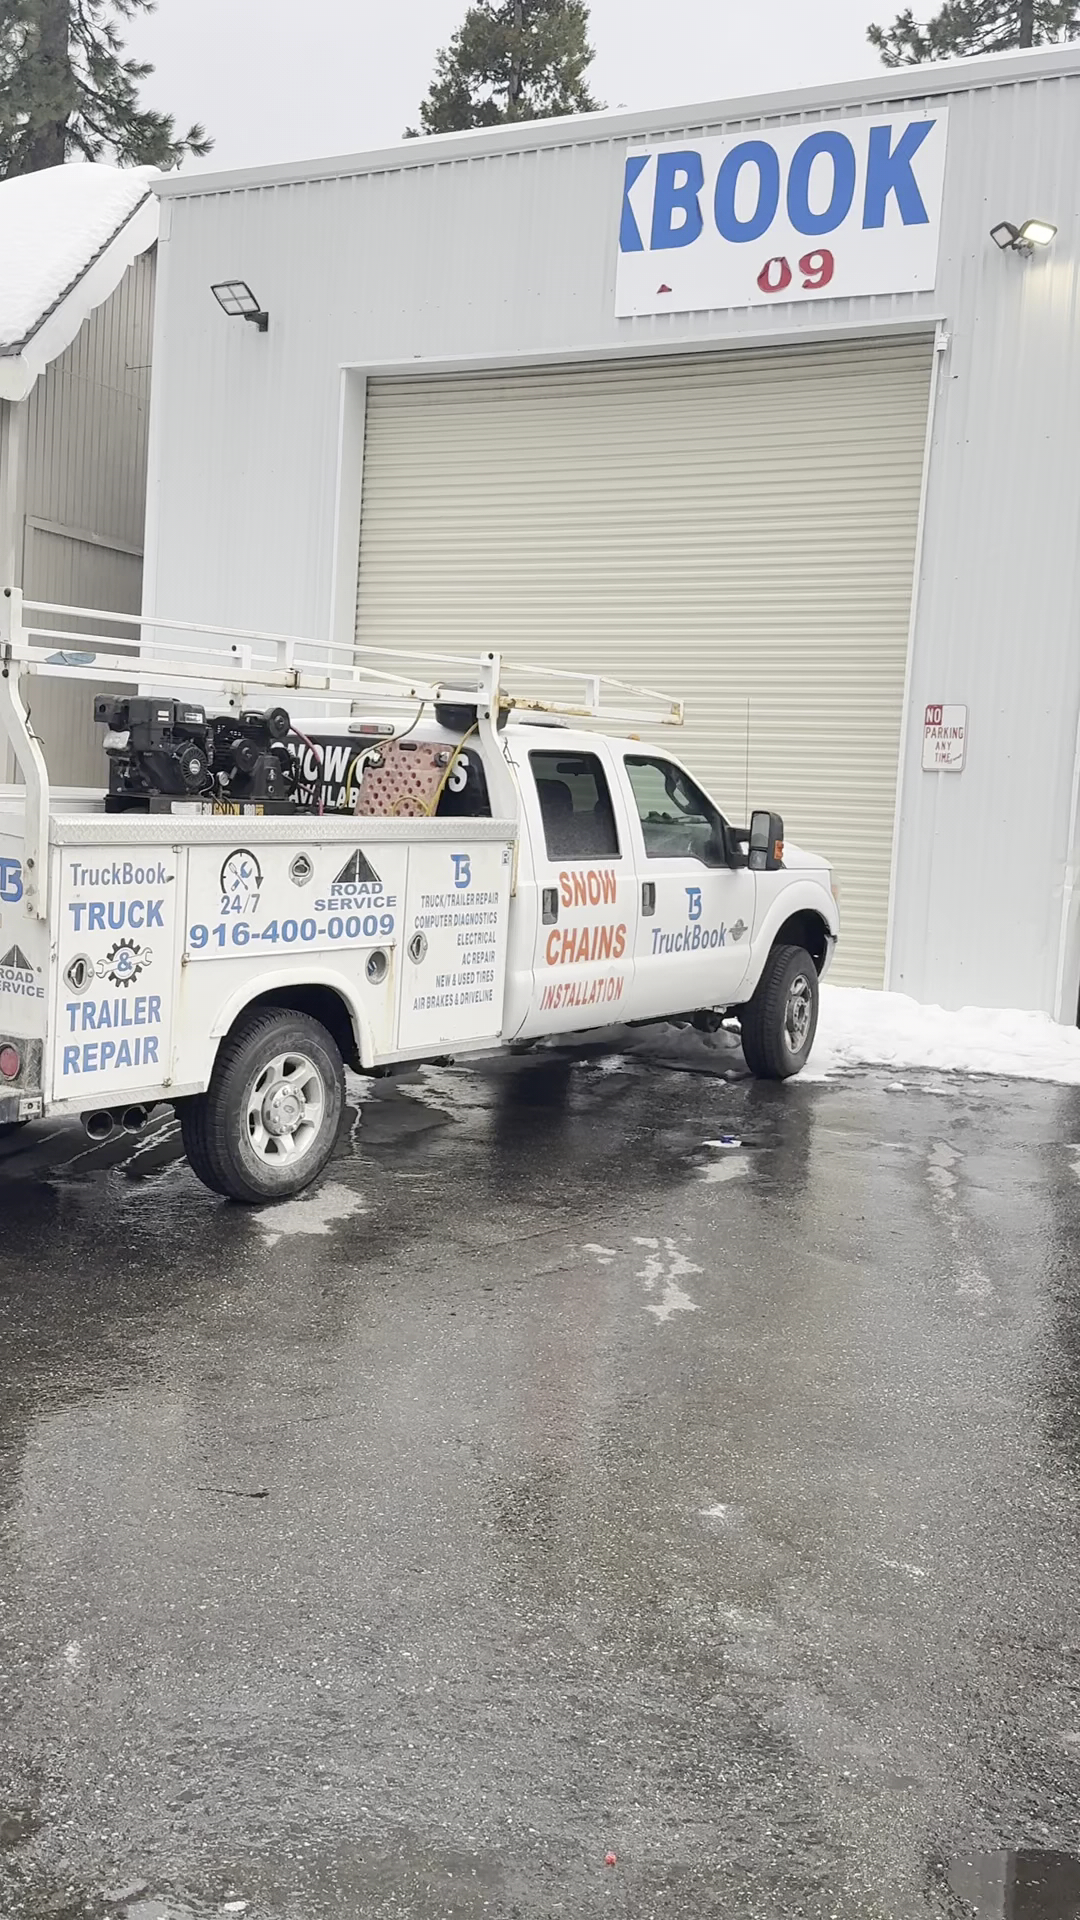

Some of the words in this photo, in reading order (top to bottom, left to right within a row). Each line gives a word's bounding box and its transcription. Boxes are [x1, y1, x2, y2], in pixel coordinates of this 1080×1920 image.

[926, 708, 942, 724] NO
[925, 727, 964, 739] PARKING
[935, 741, 952, 750] ANY
[935, 752, 951, 762] TIME
[70, 862, 166, 887] TruckBook
[331, 883, 384, 896] ROAD
[559, 869, 617, 907] SNOW
[220, 893, 261, 915] 24/7
[314, 896, 397, 911] SERVICE
[421, 893, 475, 908] TRUCK/TRAILER
[475, 892, 499, 905] REPAIR
[68, 900, 164, 931] TRUCK
[414, 914, 453, 929] COMPUTER
[453, 911, 498, 926] DIAGNOSTICS
[189, 914, 395, 949] 916-400-0009
[457, 931, 496, 946] ELECTRICAL
[651, 922, 727, 955] TruckBook
[545, 924, 627, 966] CHAINS
[461, 953, 471, 965] AC
[471, 950, 496, 965] REPAIR
[436, 975, 451, 988] NEW
[457, 972, 475, 986] USED
[476, 969, 494, 983] TIRES
[413, 997, 425, 1010] AIR
[426, 993, 453, 1009] BRAKES
[460, 989, 493, 1005] DRIVELINE
[539, 976, 625, 1011] INSTALLATION
[66, 995, 162, 1032] TRAILER
[63, 1036, 159, 1075] REPAIR
